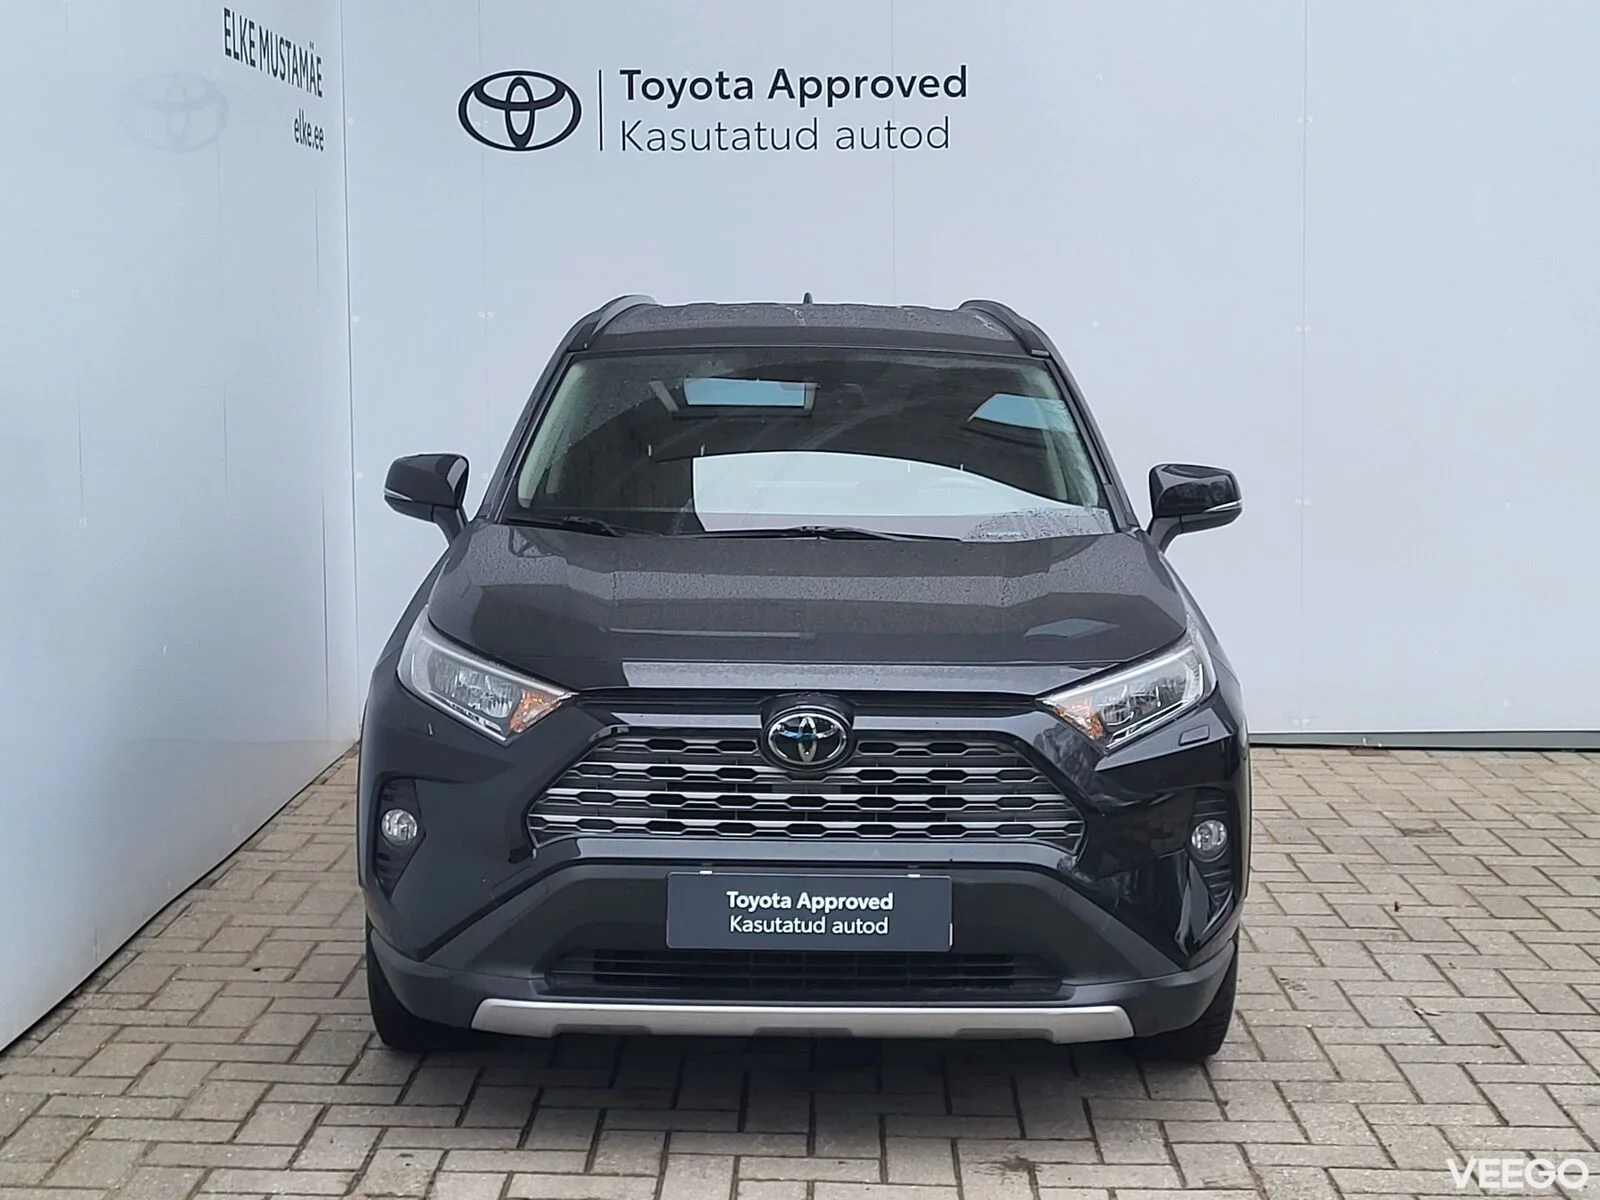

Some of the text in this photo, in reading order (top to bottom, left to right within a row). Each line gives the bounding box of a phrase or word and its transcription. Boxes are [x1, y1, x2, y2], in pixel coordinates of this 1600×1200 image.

[223, 7, 323, 98] ELKE MUSTAMÄE
[620, 65, 967, 109] Toyota Approved
[293, 107, 324, 152] elke.ee
[620, 116, 949, 152] Kasutatud autod
[726, 890, 894, 914] Toyota Approved
[730, 915, 889, 935] Kasutatud autod
